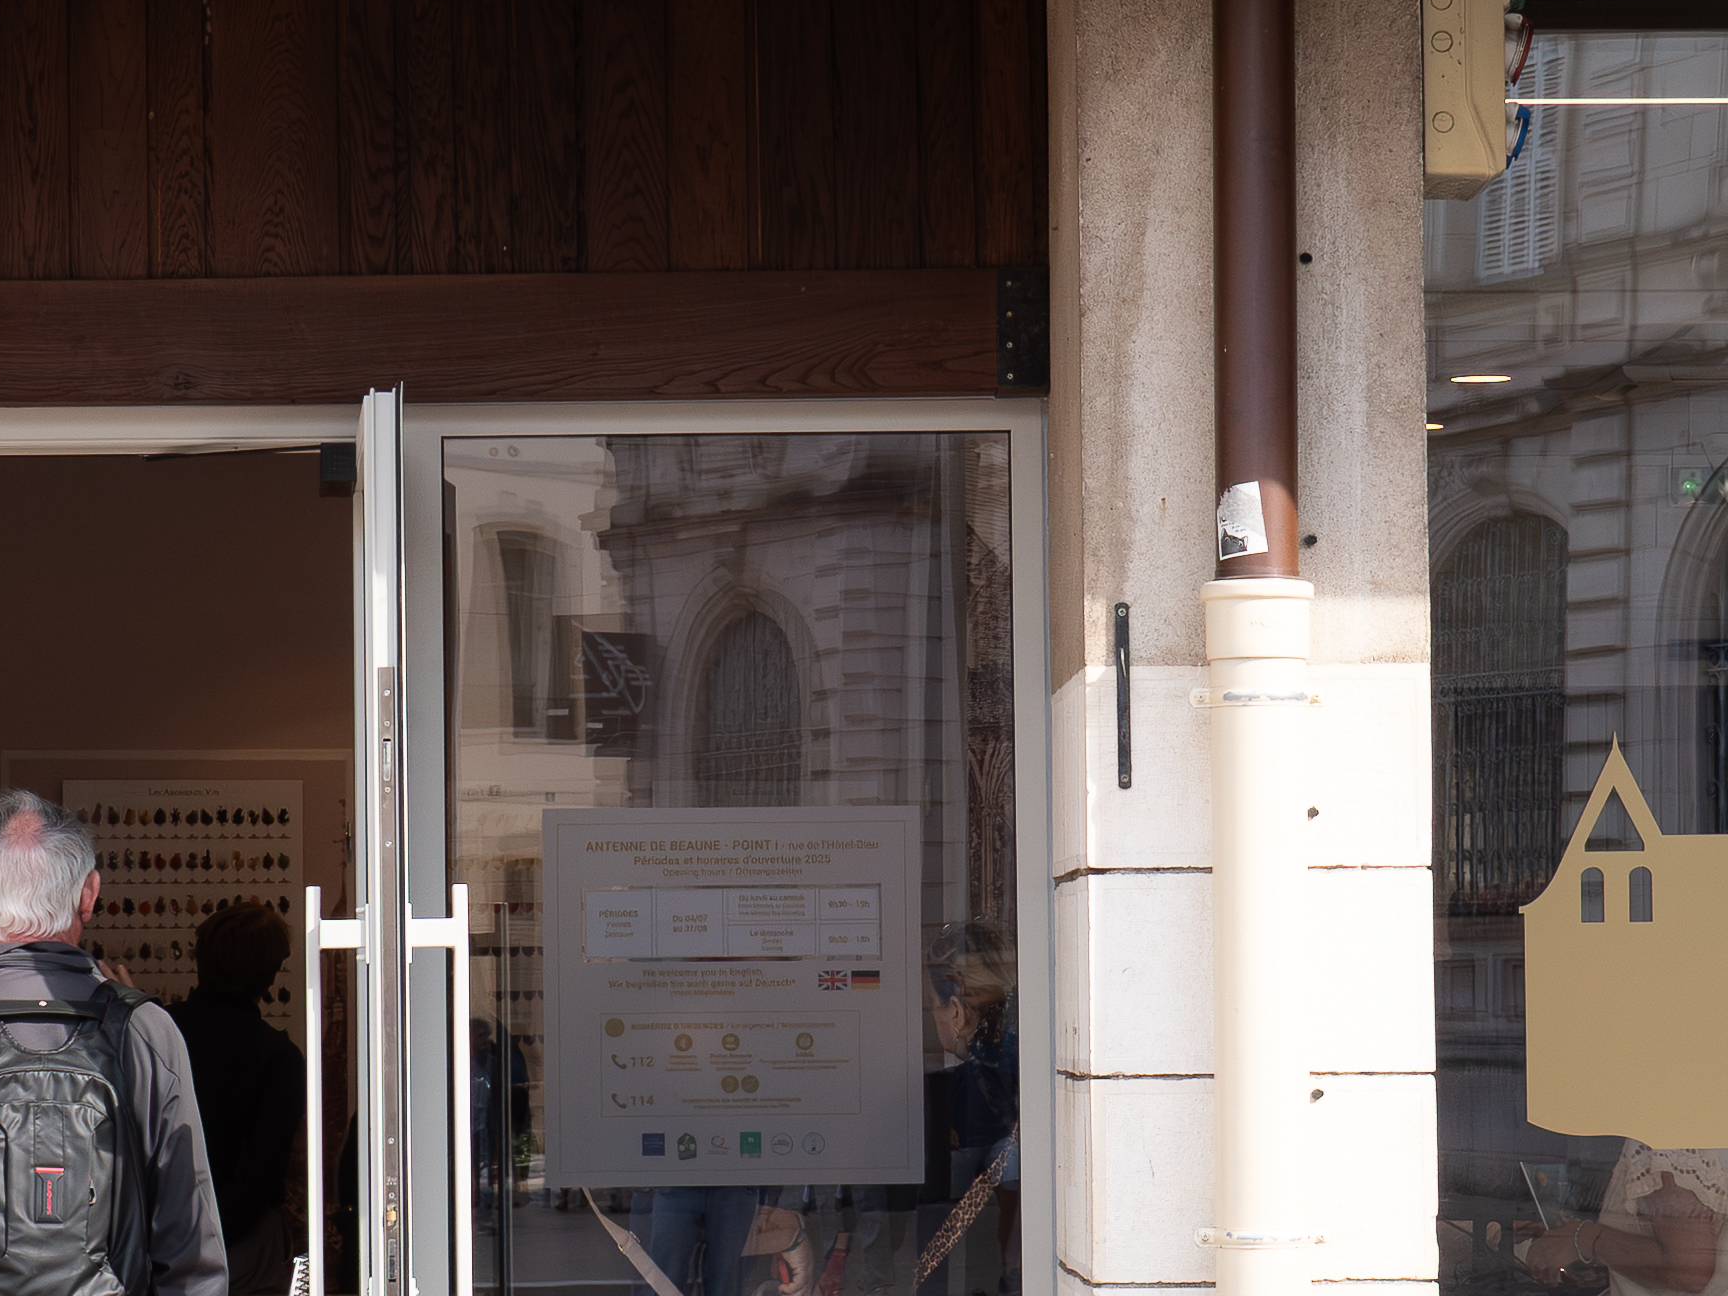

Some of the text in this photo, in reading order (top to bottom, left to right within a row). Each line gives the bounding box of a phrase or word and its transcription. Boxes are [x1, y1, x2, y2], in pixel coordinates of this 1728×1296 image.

[585, 840, 646, 852] ANTENNE
[650, 840, 666, 851] DE
[669, 840, 721, 851] BEAUNE
[732, 839, 772, 851] POINT
[633, 855, 680, 866] Périodes
[683, 856, 693, 865] et
[696, 855, 739, 865] horaires
[630, 1056, 655, 1068] 112
[630, 1095, 655, 1107] 114
